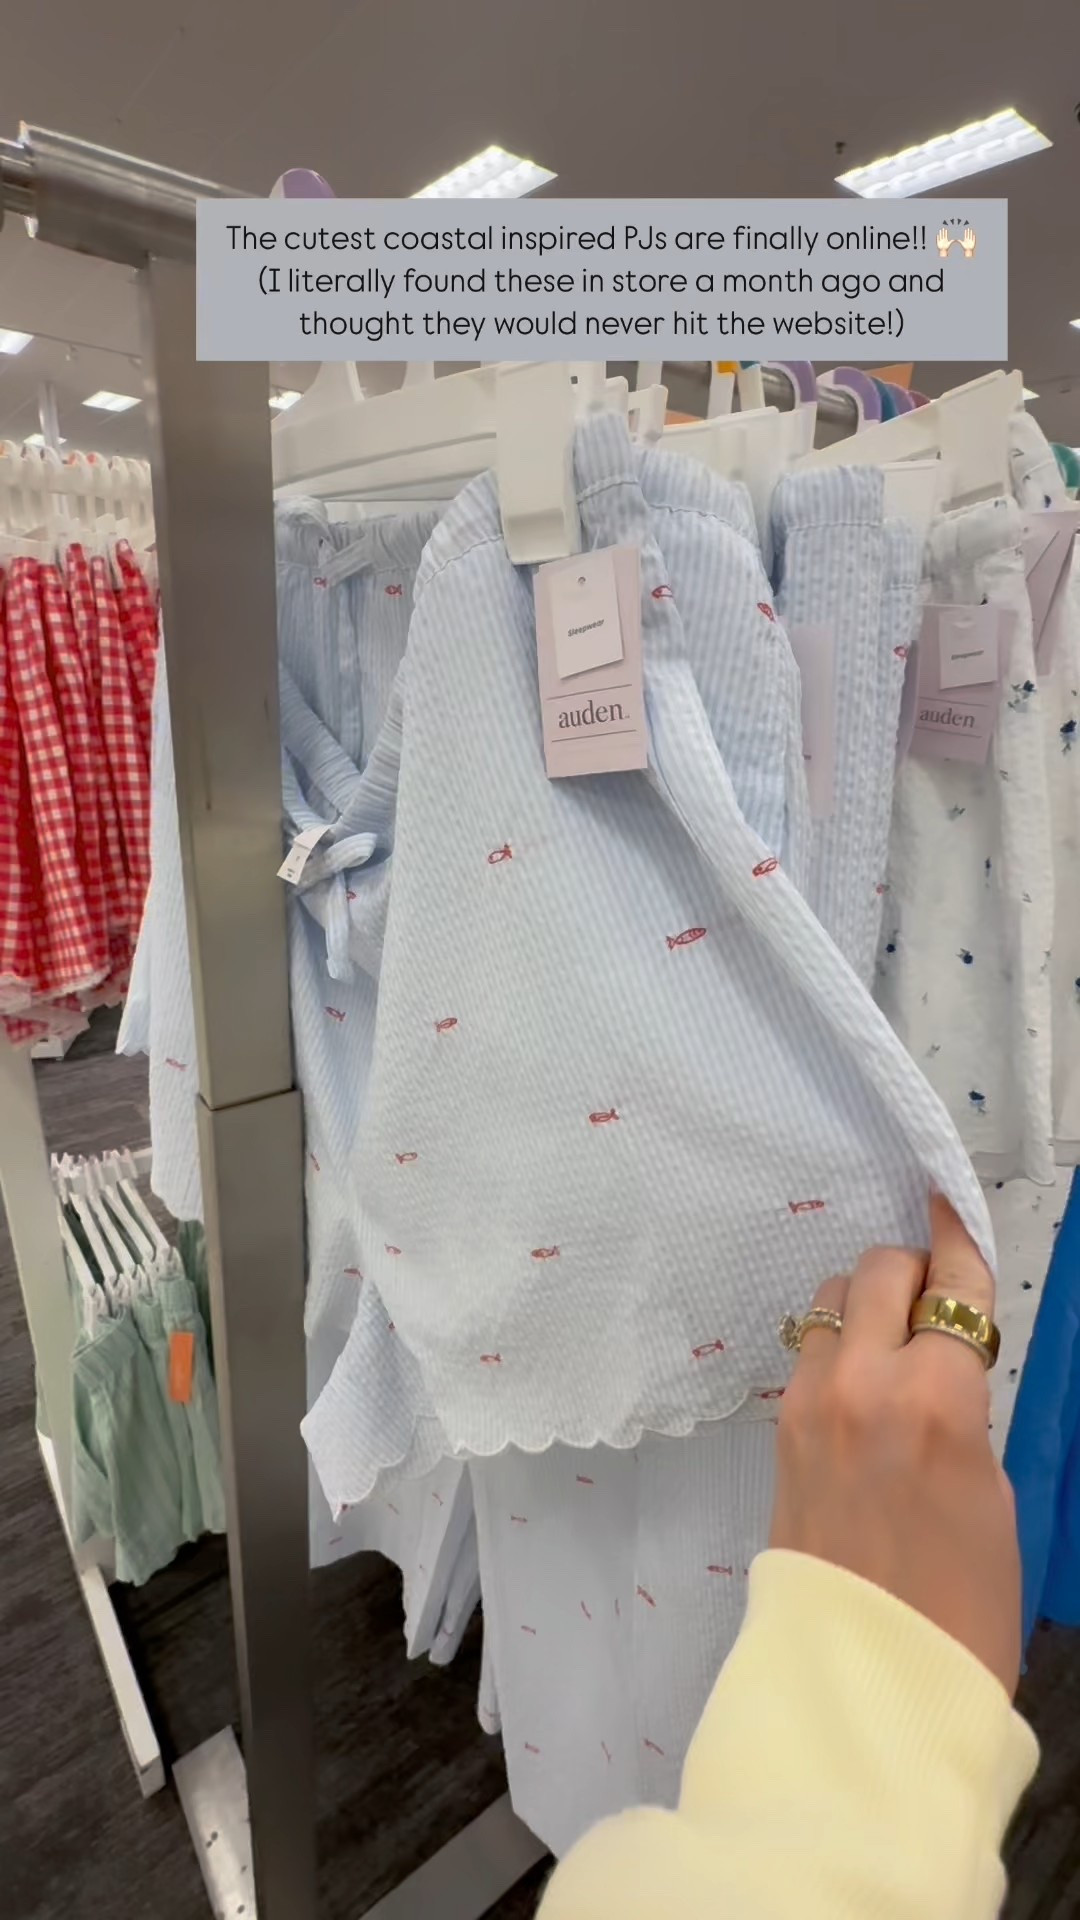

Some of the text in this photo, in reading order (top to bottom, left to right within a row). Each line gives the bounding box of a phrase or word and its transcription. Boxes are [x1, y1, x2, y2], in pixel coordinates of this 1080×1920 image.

[567, 619, 605, 637] Sleepwear
[558, 700, 623, 728] auden
[919, 707, 975, 728] auden
